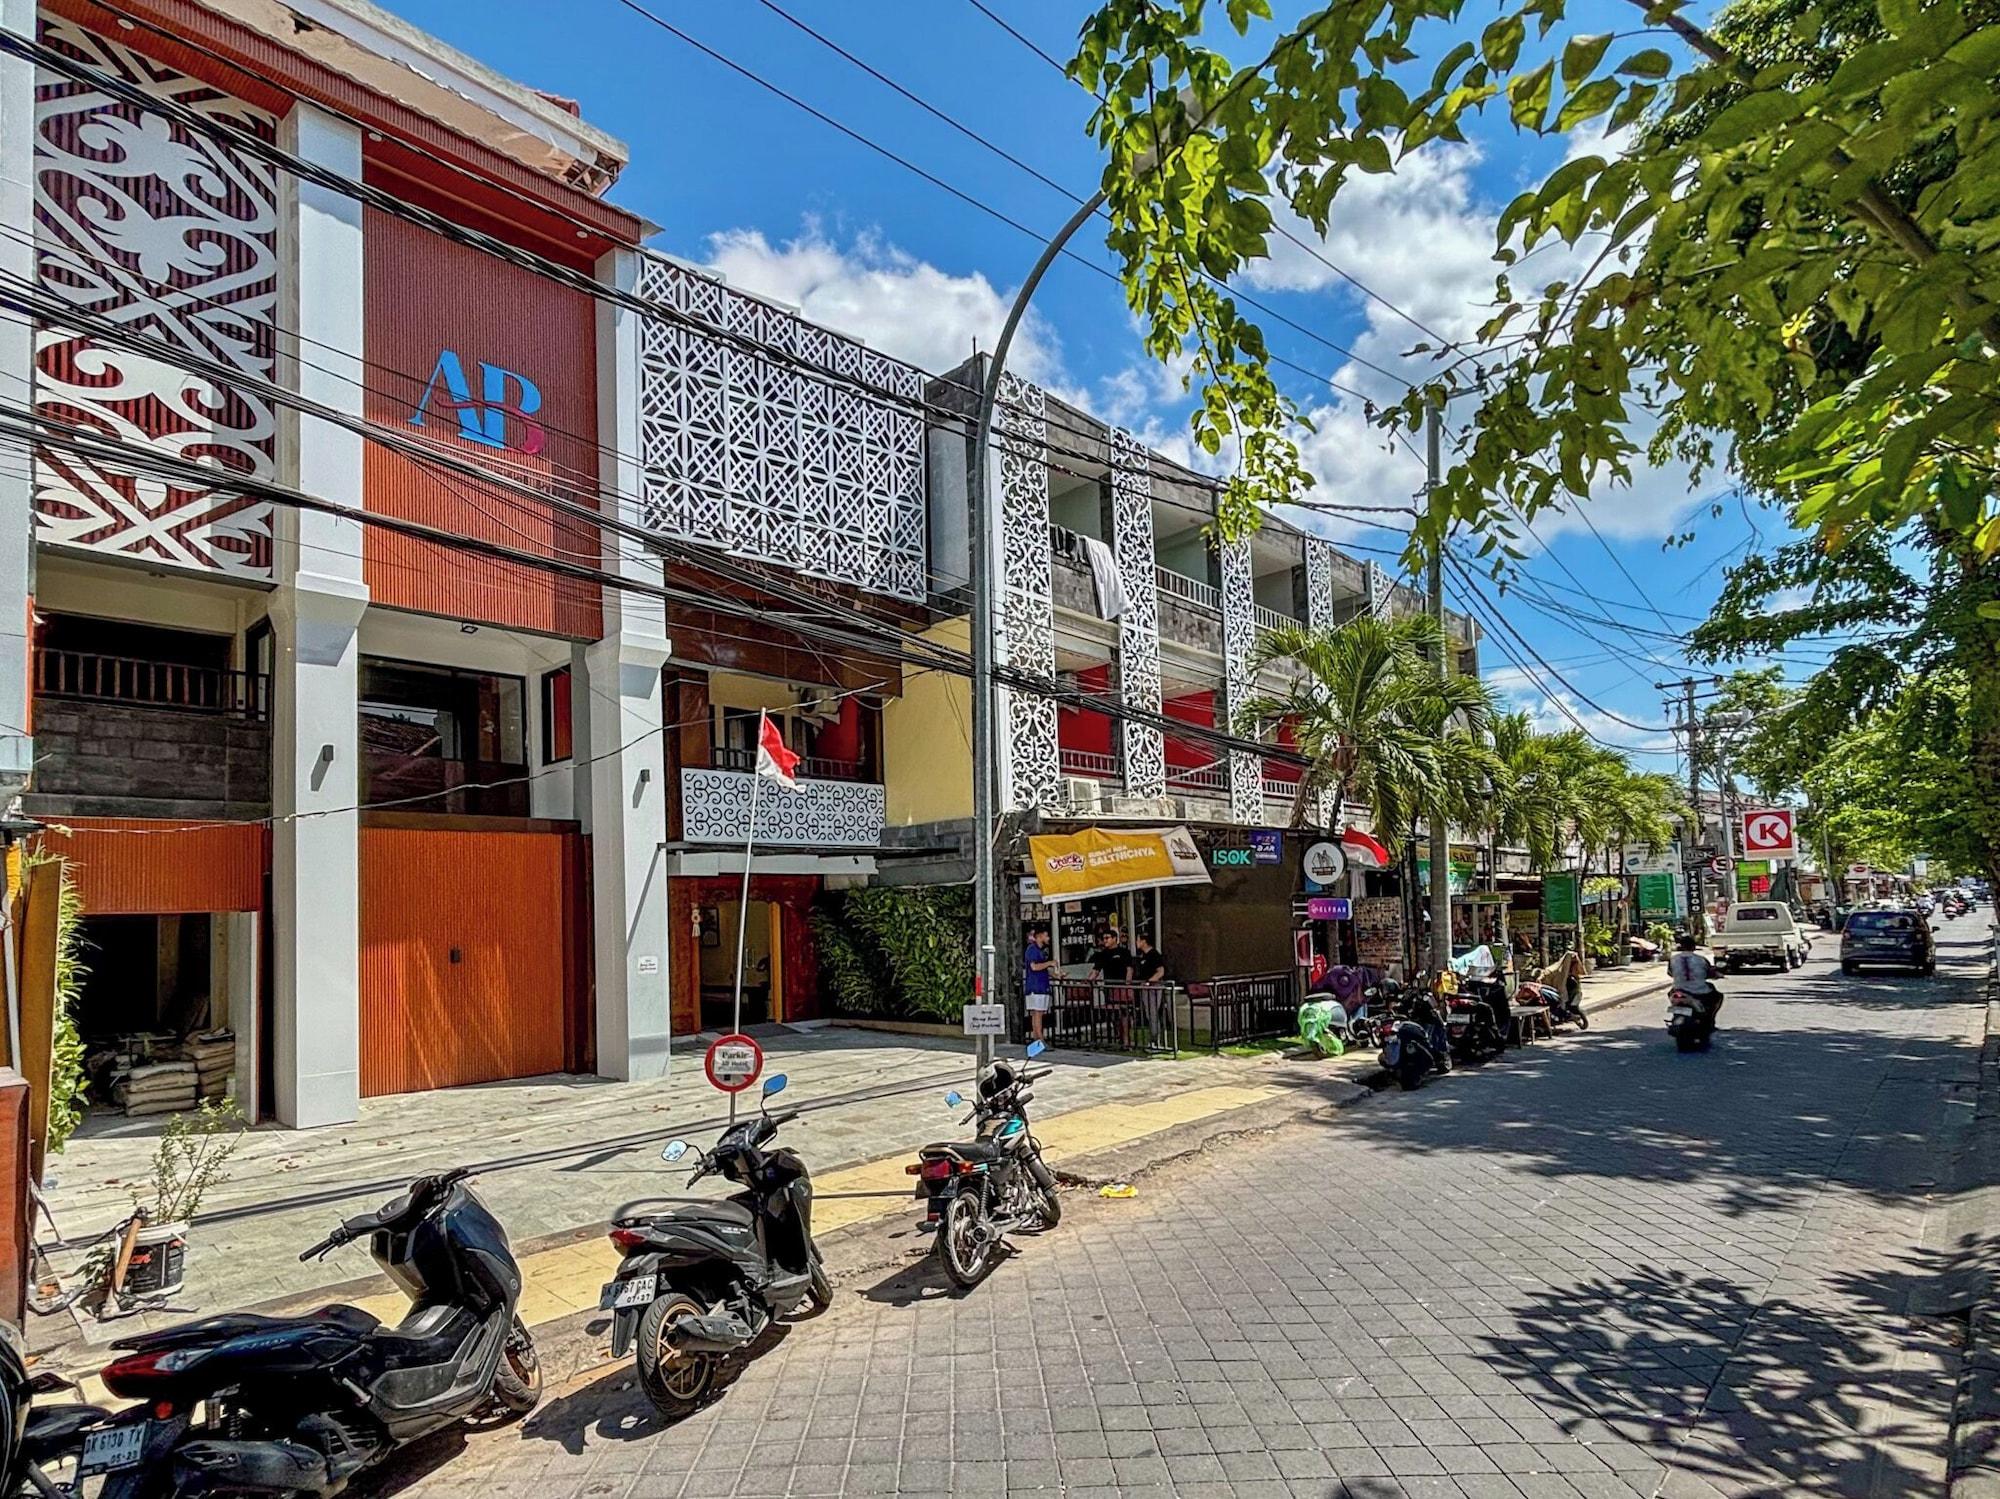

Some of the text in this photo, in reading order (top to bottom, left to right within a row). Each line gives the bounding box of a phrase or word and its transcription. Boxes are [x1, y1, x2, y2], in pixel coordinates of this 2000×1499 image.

[1759, 822, 1784, 842] K
[1213, 850, 1251, 864] ISOK
[1688, 870, 1700, 911] TATTOO
[84, 1436, 98, 1454] DK
[100, 1432, 124, 1450] 6130
